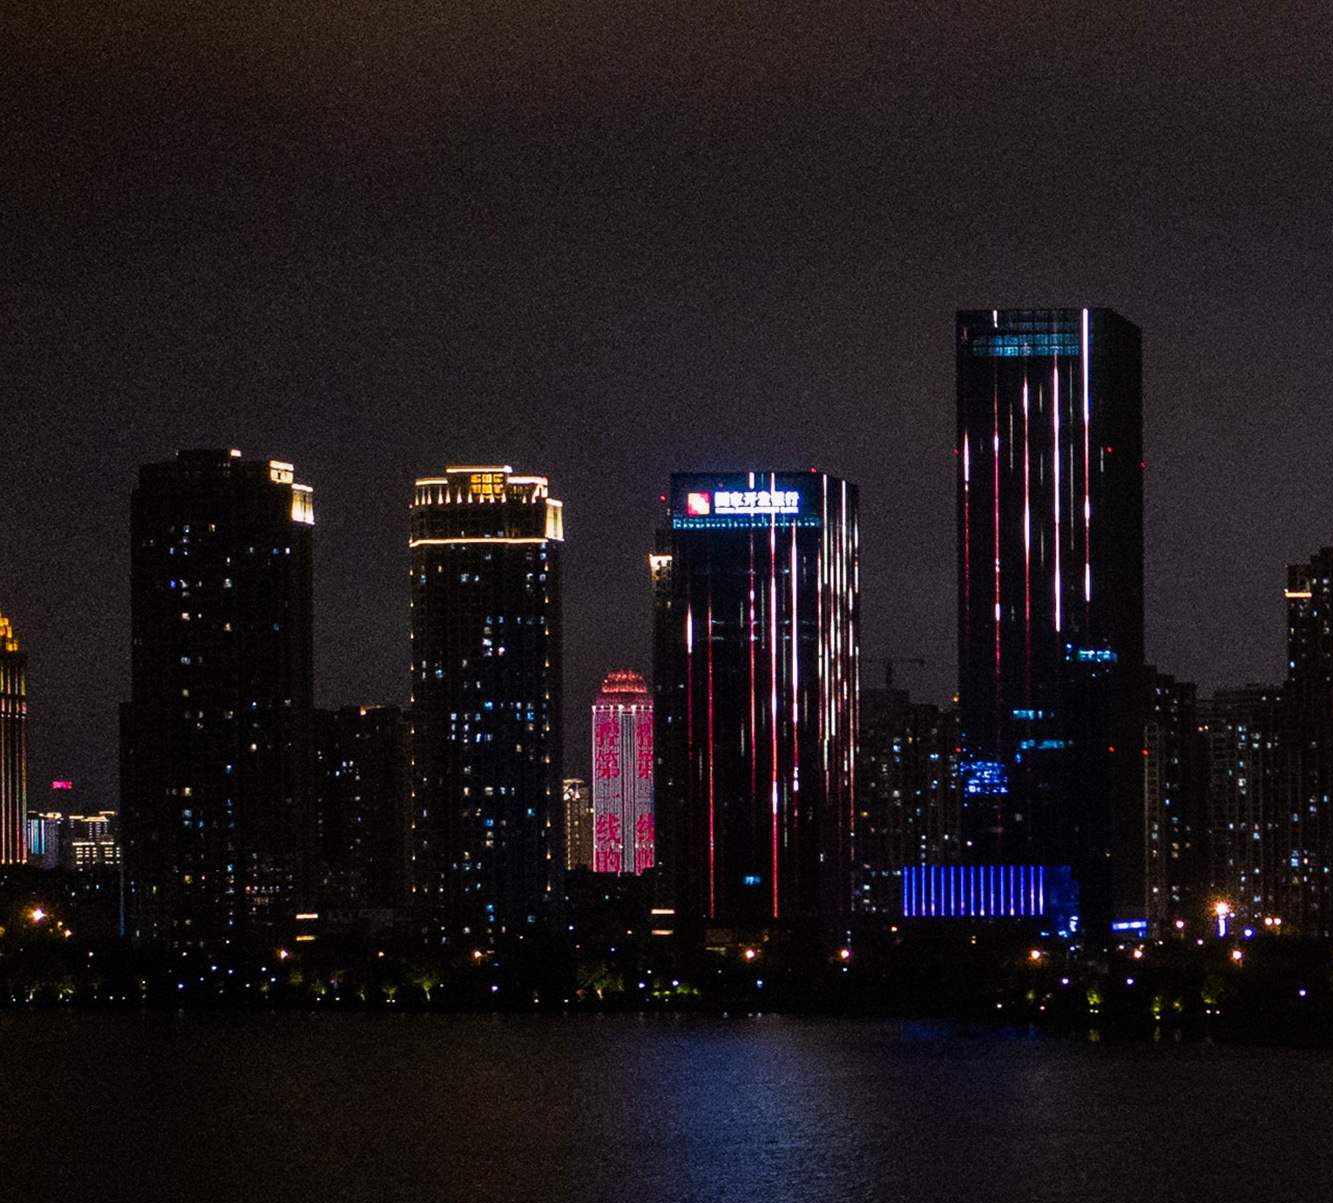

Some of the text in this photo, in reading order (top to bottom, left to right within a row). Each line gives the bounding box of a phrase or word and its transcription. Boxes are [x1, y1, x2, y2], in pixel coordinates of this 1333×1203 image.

[714, 490, 799, 508] 国家开发银行
